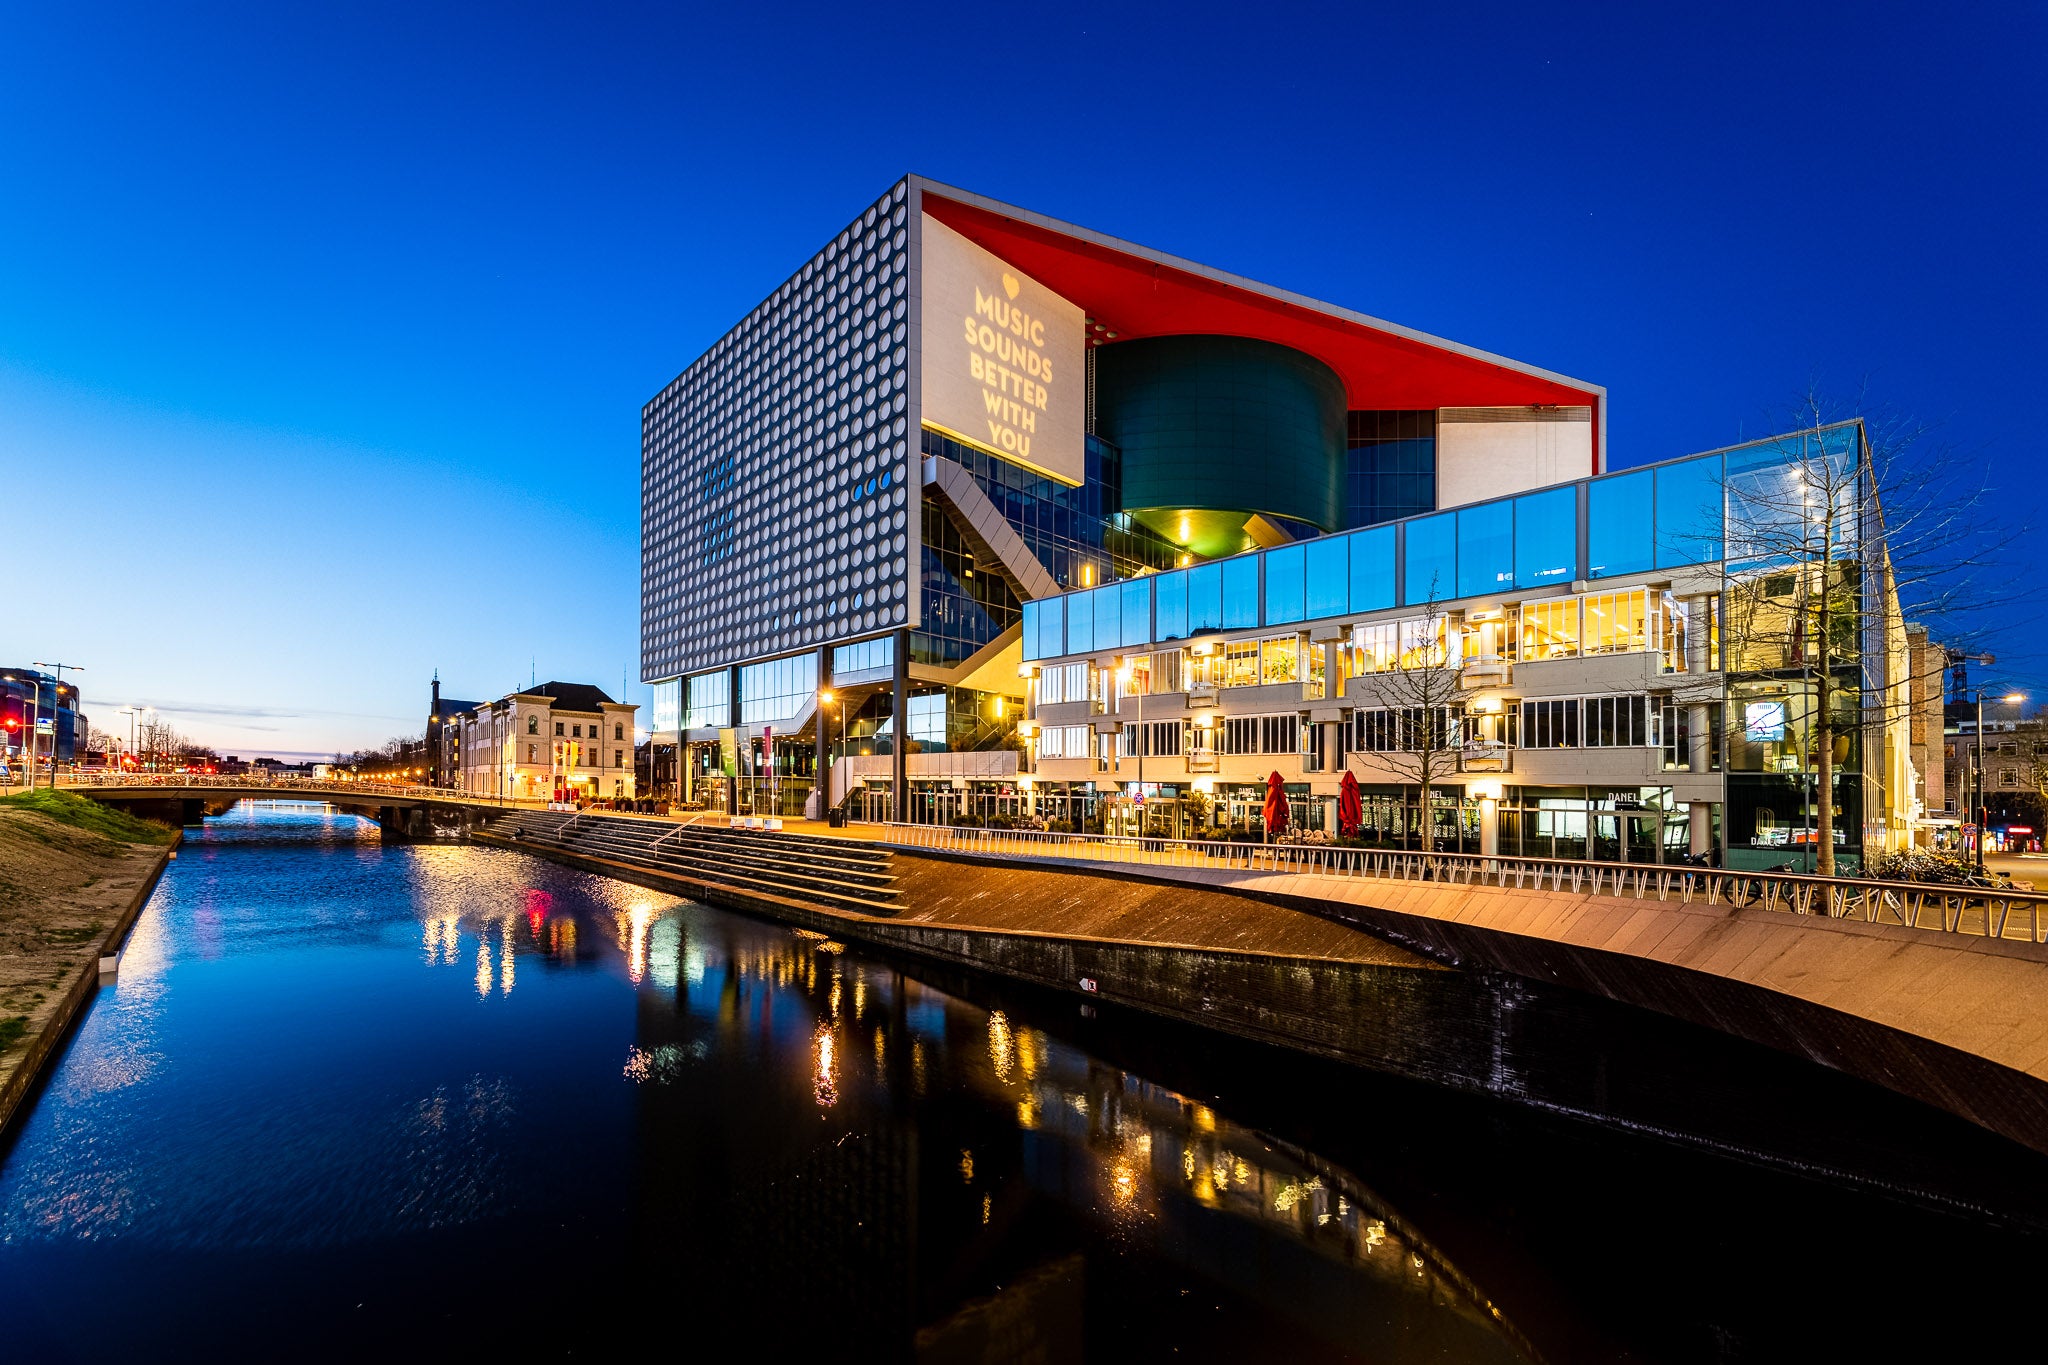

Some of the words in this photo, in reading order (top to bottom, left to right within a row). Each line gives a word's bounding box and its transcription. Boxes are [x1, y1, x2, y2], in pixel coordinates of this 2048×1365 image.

[975, 285, 1045, 348] MUSIC
[964, 317, 1053, 384] SOUNDS
[970, 352, 1048, 412] BETTER
[982, 388, 1036, 434] WITH
[987, 419, 1031, 457] YOU
[1608, 792, 1641, 802] DANEL
[1750, 836, 1780, 847] DANEL
